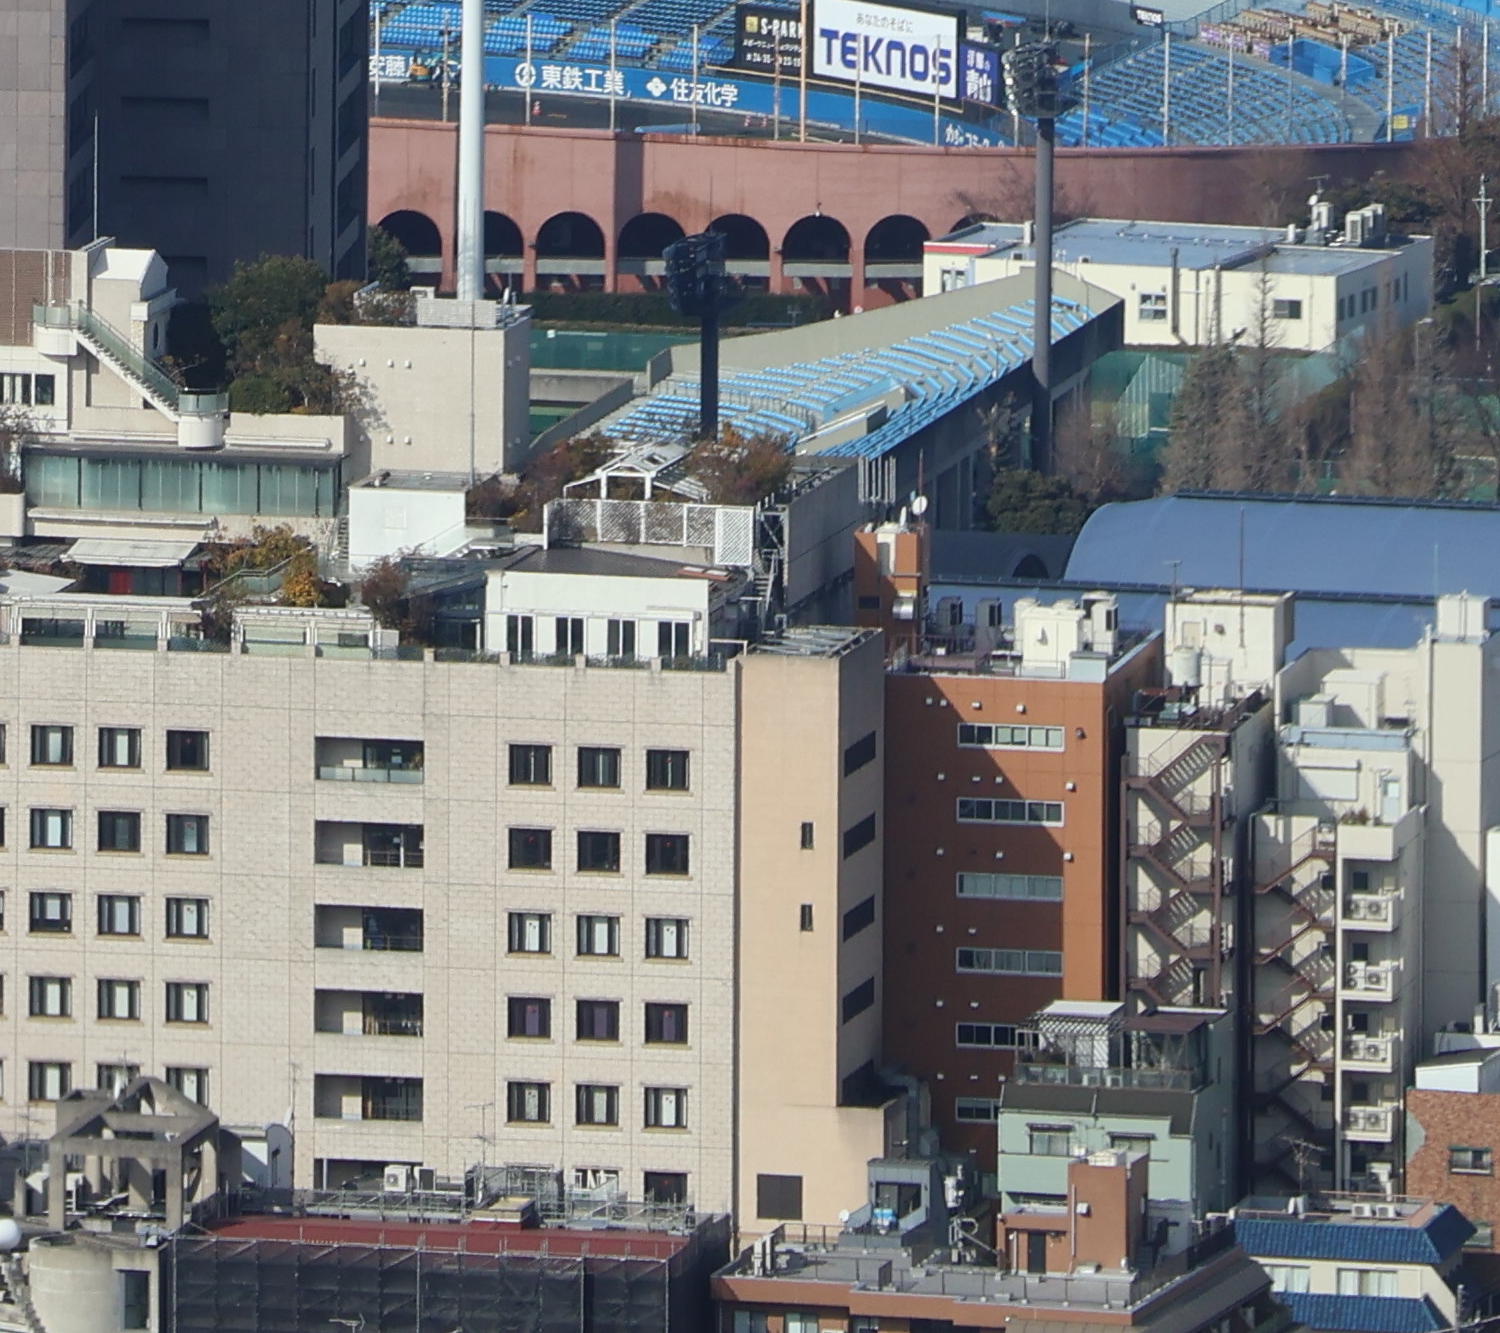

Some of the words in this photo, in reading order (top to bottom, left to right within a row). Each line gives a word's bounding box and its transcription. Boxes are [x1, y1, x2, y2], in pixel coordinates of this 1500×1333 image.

[856, 12, 913, 32] あなたのそばに
[819, 27, 951, 86] TEKNOS
[669, 77, 738, 108] 住友化学
[965, 68, 992, 103] 青山
